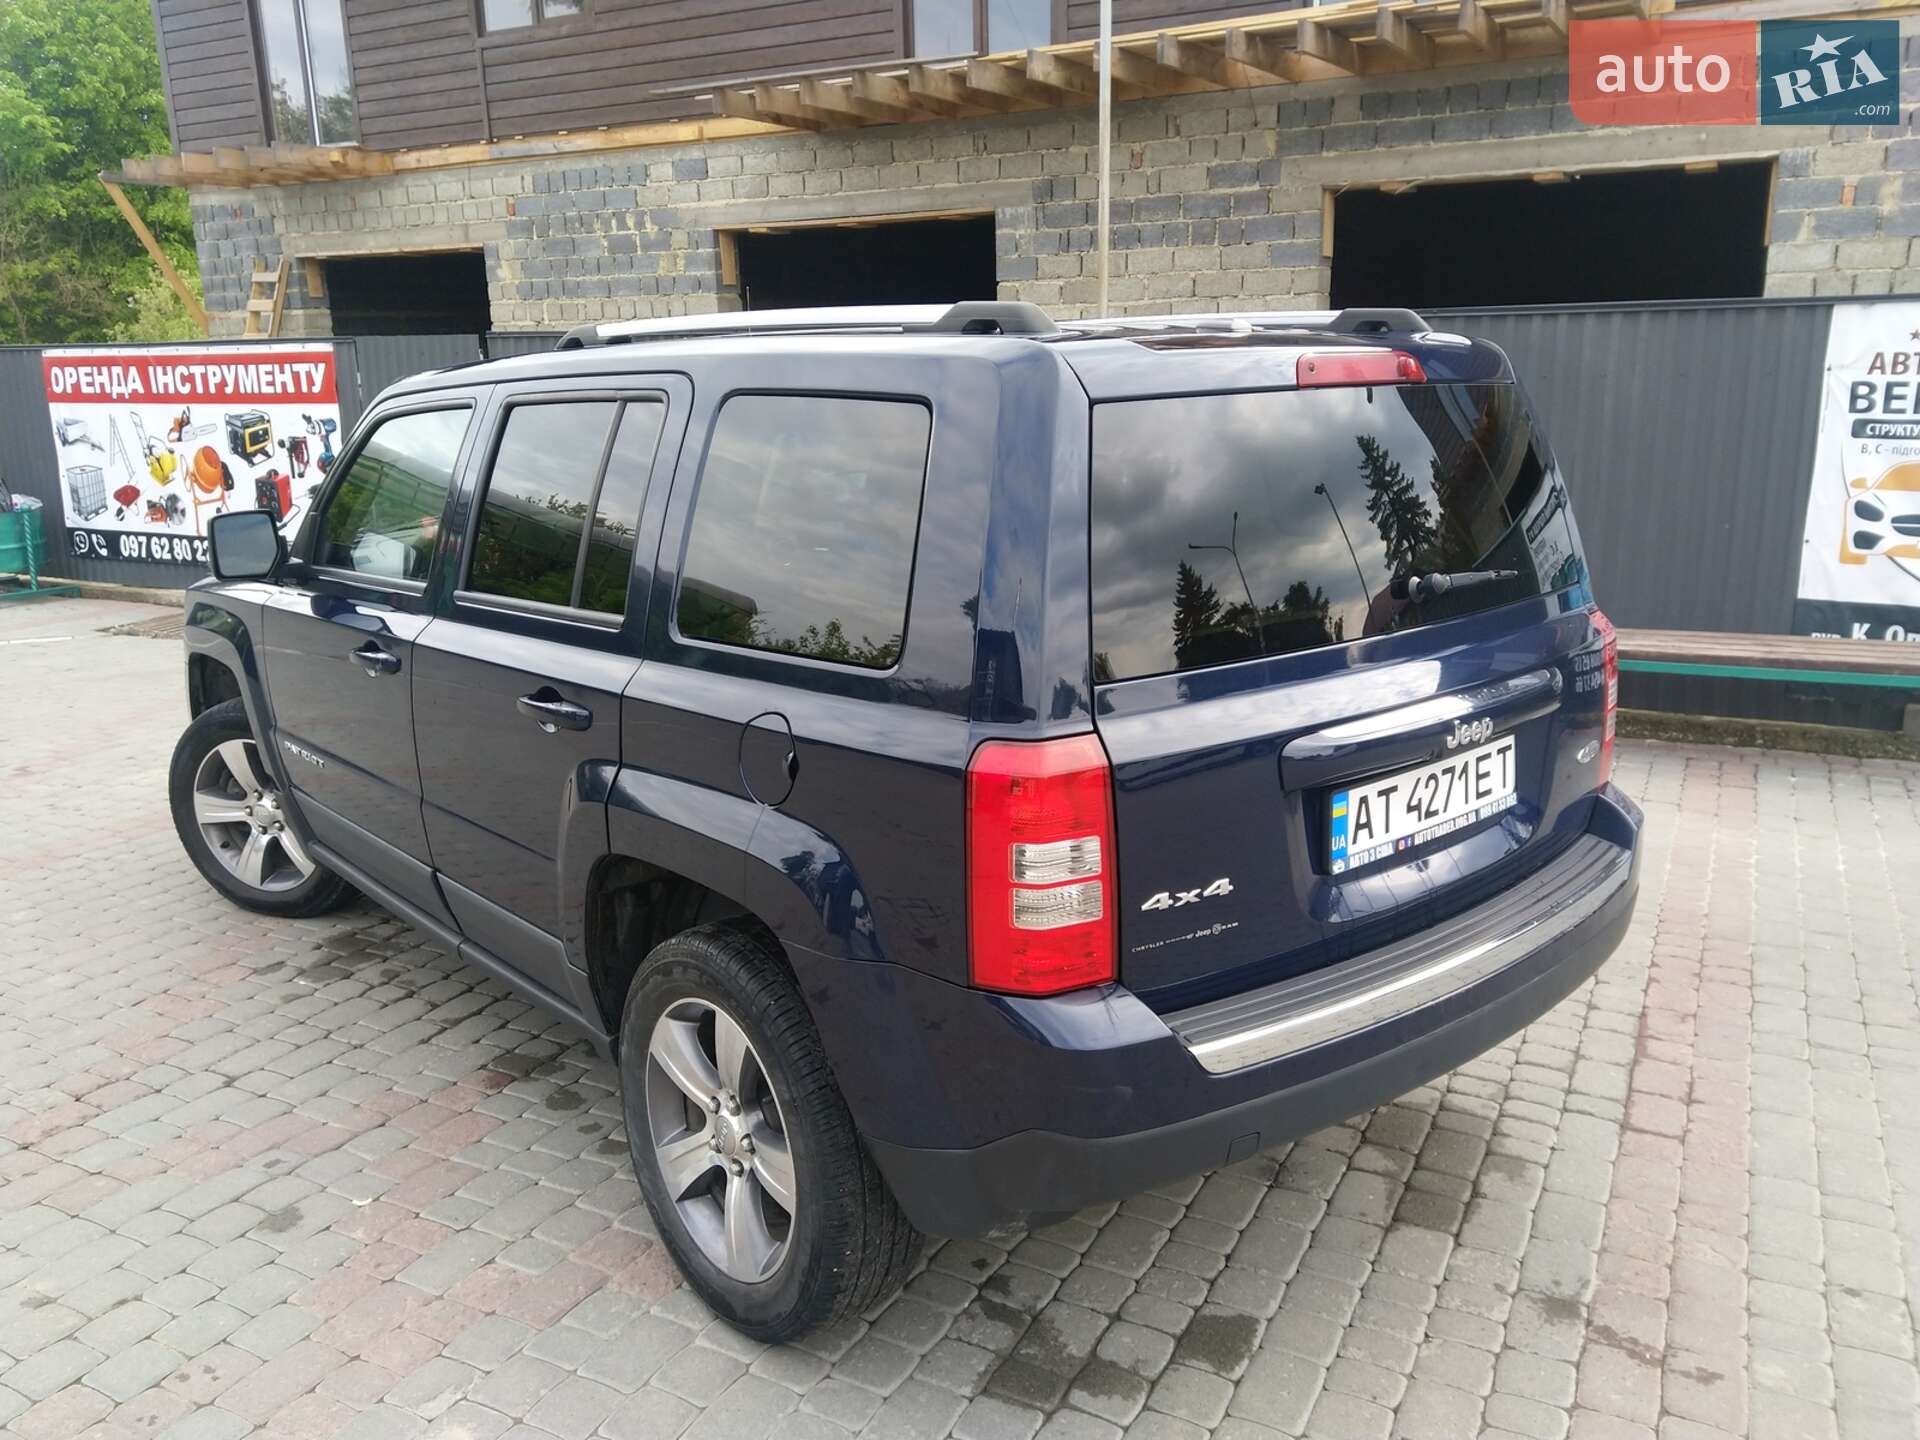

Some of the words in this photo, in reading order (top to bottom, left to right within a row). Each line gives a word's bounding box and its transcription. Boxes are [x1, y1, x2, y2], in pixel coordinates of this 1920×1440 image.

[50, 365, 144, 399] ОРЕНДА
[148, 362, 325, 395] ІНСТРУМЕНТУ
[1848, 381, 1920, 414] ВЕ
[120, 534, 148, 558] 097
[151, 536, 172, 560] 62
[173, 538, 193, 561] 80
[1447, 716, 1494, 749] Jeep
[1351, 784, 1398, 846] AT
[1332, 833, 1346, 851] UA
[1141, 878, 1234, 911] 4x4
